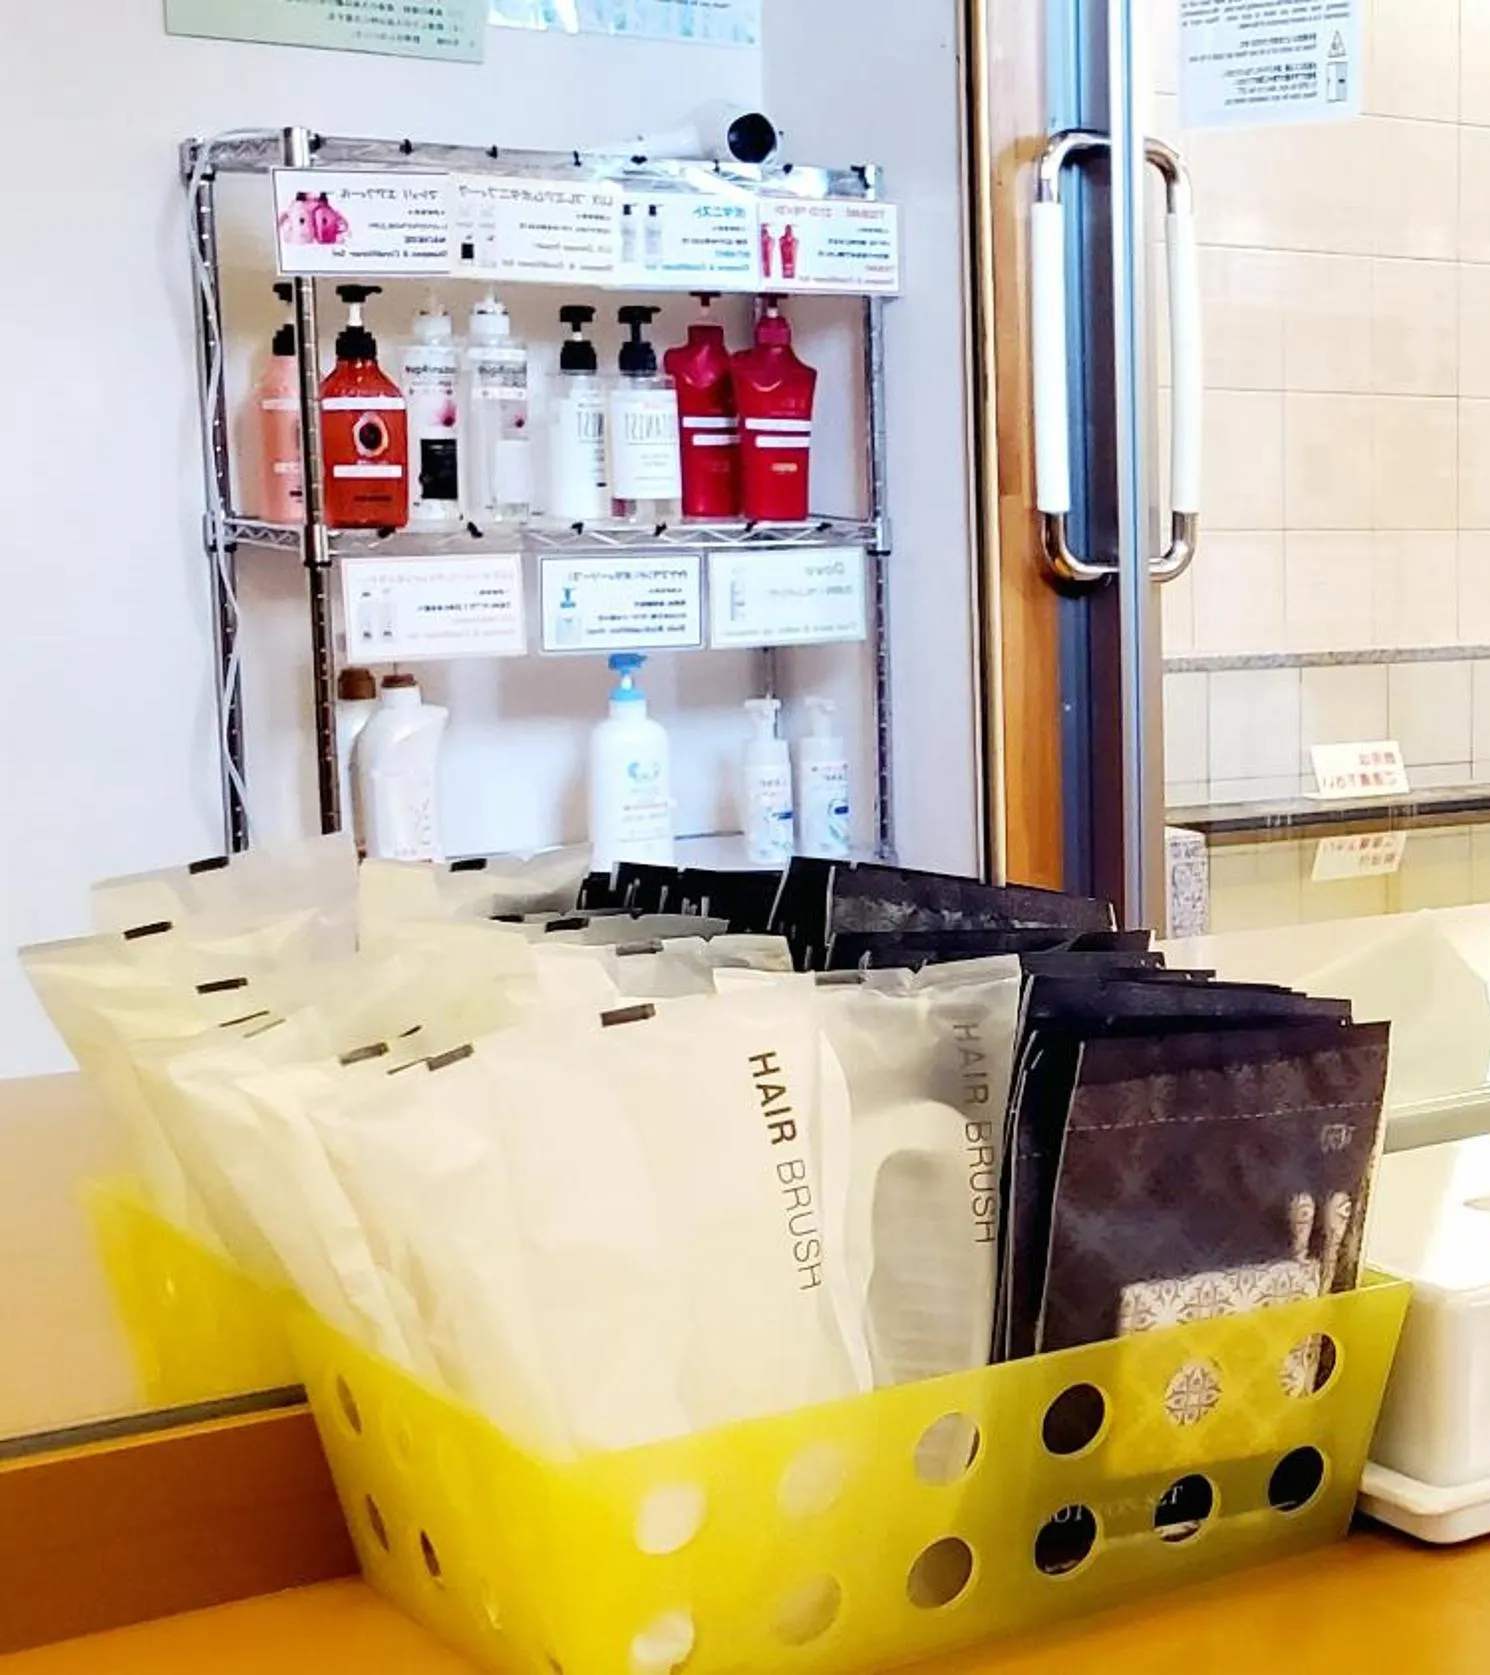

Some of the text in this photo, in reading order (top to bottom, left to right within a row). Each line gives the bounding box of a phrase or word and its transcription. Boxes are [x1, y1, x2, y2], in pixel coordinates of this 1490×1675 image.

[748, 1050, 823, 1290] HAIR BRUSH
[953, 1022, 997, 1244] HAIR BRUSH
